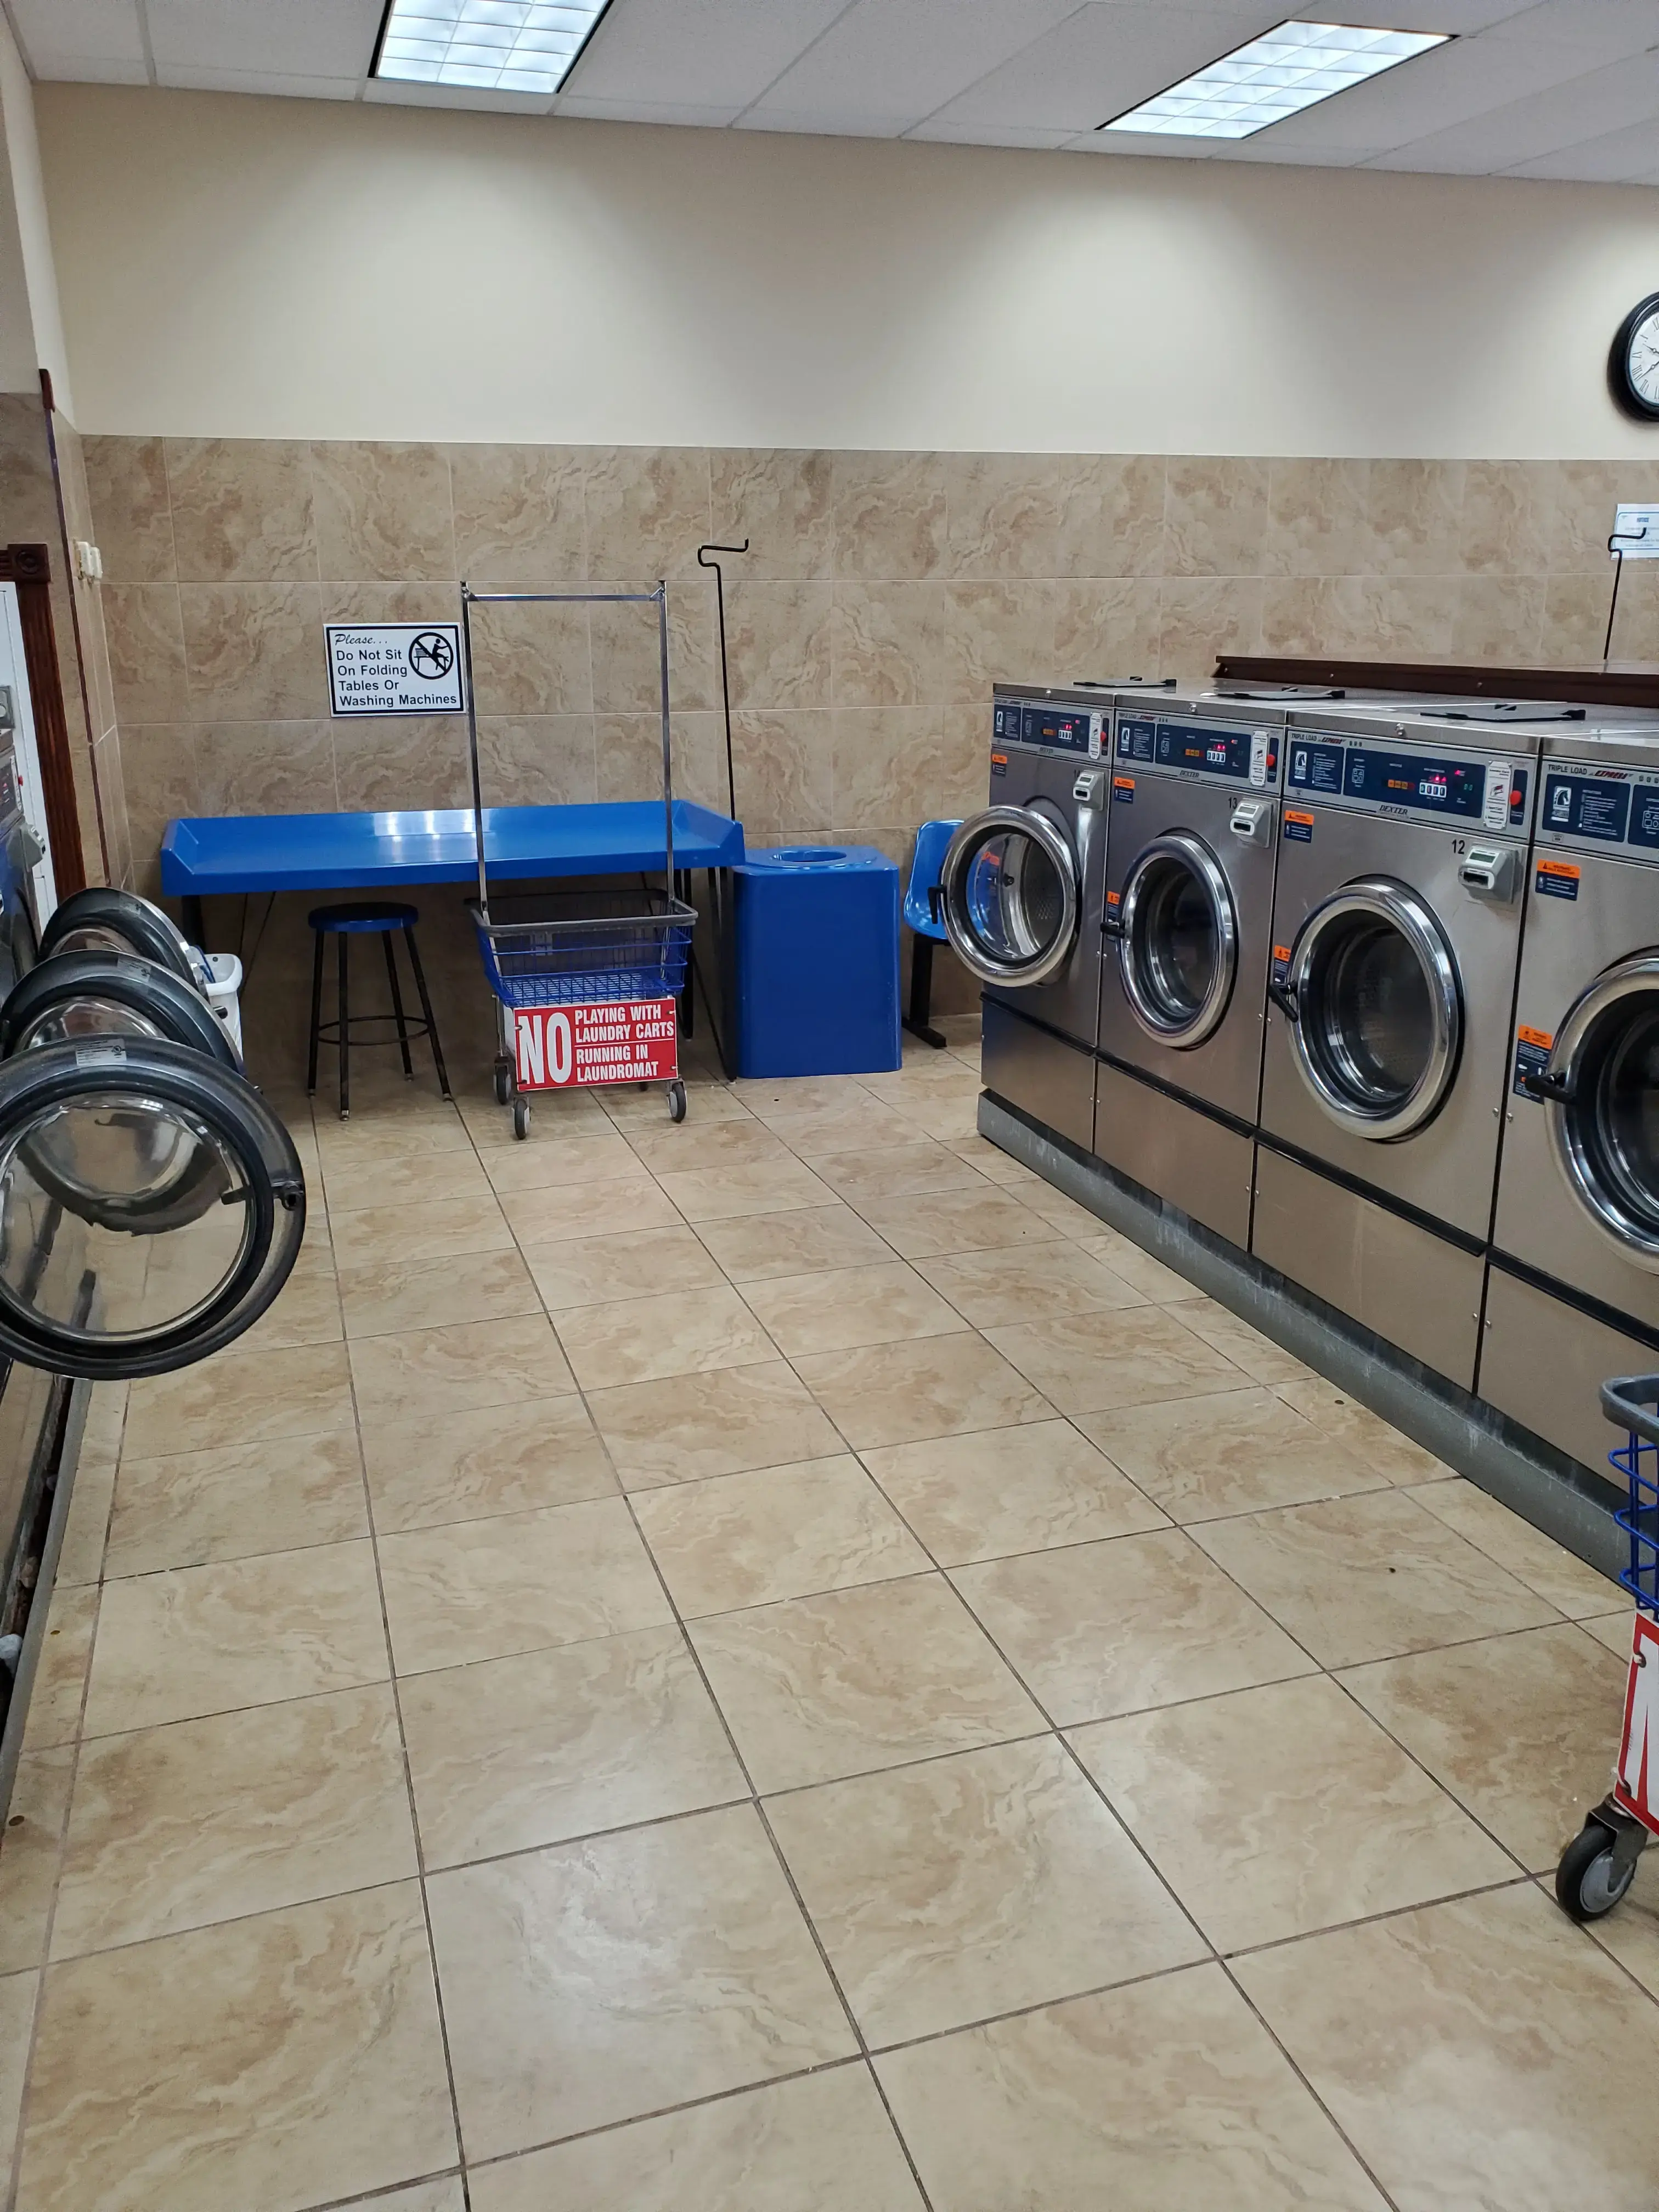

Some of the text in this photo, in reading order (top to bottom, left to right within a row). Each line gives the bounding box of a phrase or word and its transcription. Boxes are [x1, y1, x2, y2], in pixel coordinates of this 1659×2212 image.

[336, 649, 402, 661] Do Not Sit
[338, 665, 407, 677] On Folding
[338, 680, 399, 691] Tables Or
[340, 694, 456, 708] Washing Machines
[1548, 764, 1568, 773] TRIPLE
[1570, 766, 1587, 775] LOAD
[1228, 796, 1238, 809] 13
[1379, 805, 1408, 815] DEXTER
[1452, 839, 1465, 855] 12
[574, 1005, 661, 1025] PLAYING WITH
[575, 1021, 674, 1042] LAUNDRY CARTS
[518, 1012, 572, 1085] NO
[577, 1044, 648, 1064] RUNNING IN
[577, 1061, 659, 1082] LAUNDROMAT
